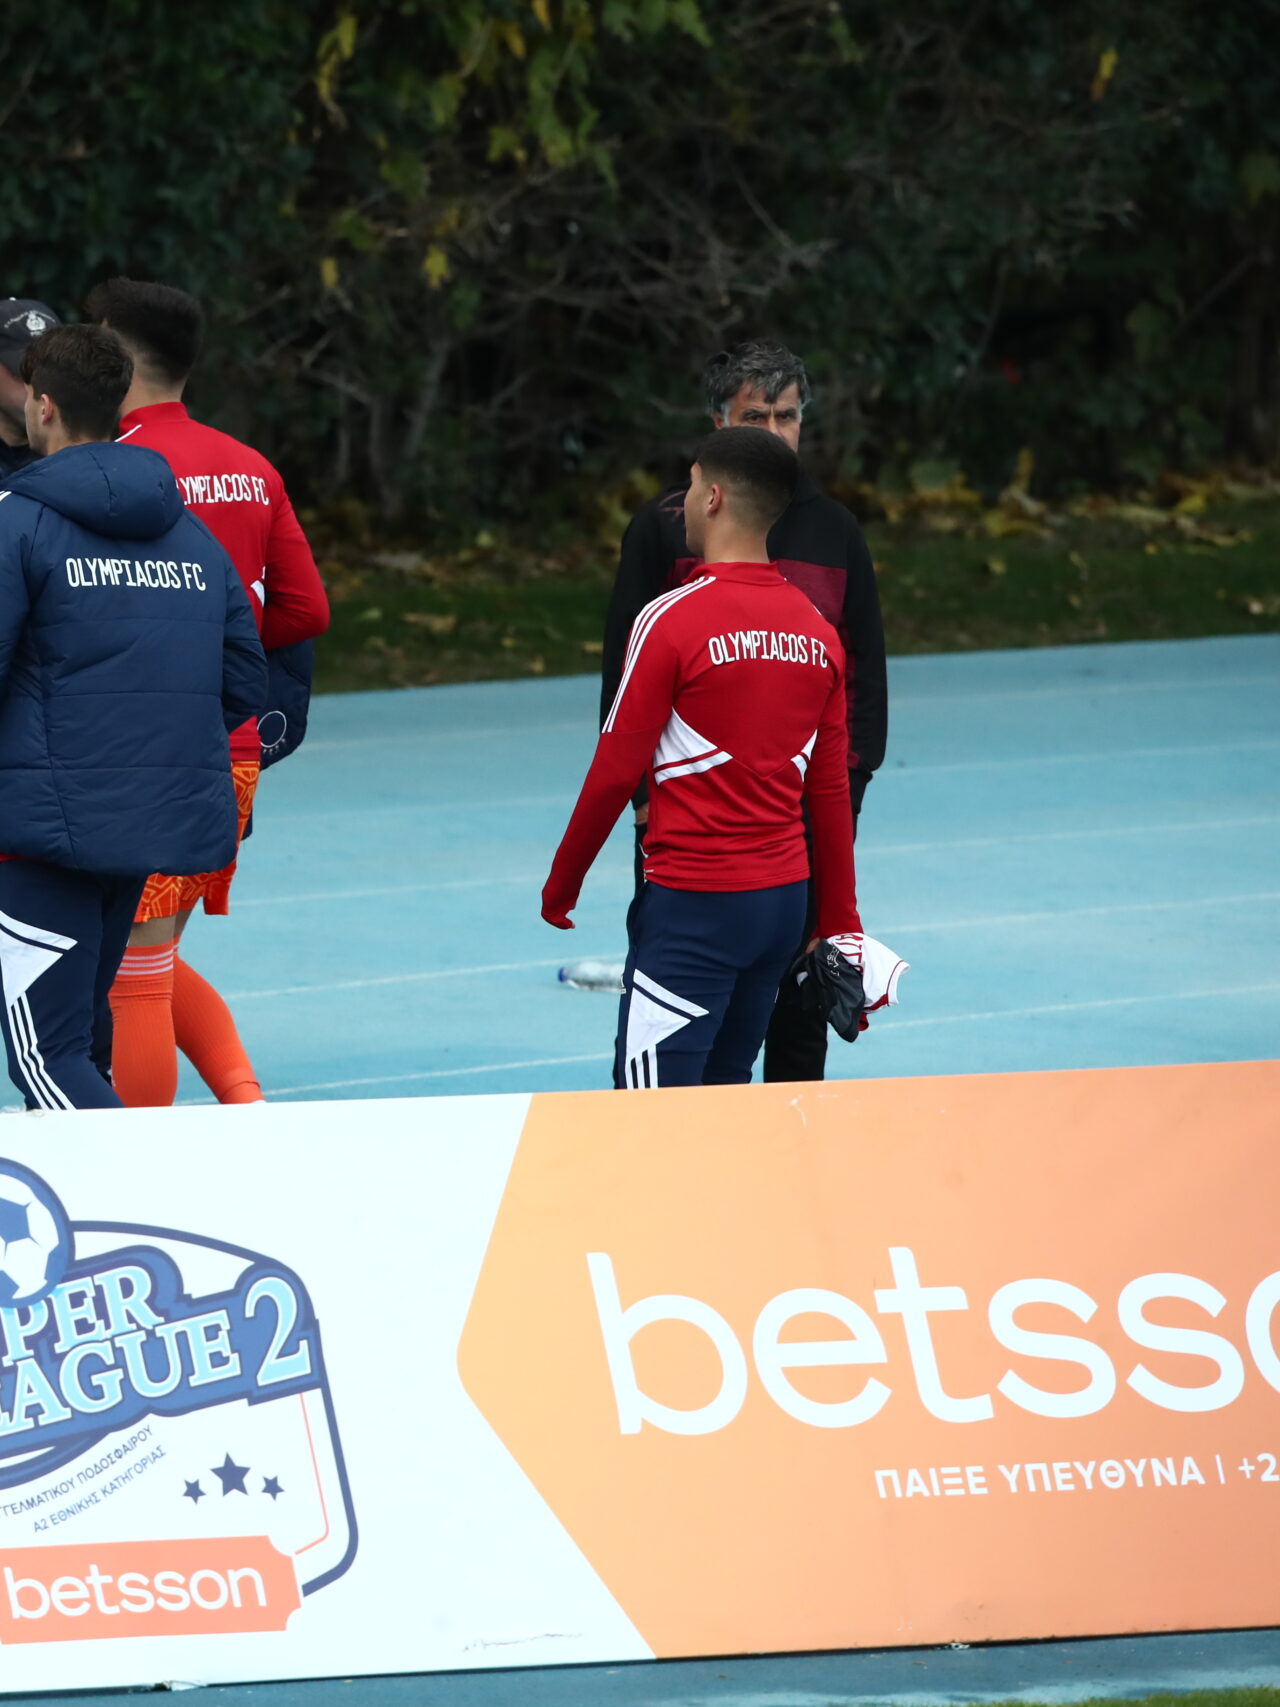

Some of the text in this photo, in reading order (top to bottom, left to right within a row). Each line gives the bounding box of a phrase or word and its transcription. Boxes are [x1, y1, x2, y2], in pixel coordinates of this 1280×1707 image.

[176, 474, 269, 506] YMPIACOS FC
[66, 557, 207, 592] OLYMPIACOS FC
[708, 630, 828, 669] OLYMPIACOS FC
[245, 1276, 312, 1388] 2
[586, 1246, 1280, 1436] betss
[76, 1424, 153, 1485] ΠΟΔΟΣΦΑΙΡΟΥ
[874, 1466, 989, 1499] ΠΑΙΞΕ
[997, 1455, 1207, 1494] ΥΠΕΥΘΥΝΑ
[51, 1492, 102, 1526] ΕΘΝΙΚΗΣ
[101, 1444, 167, 1497] ΚΑΤΗΓΟΡΙΑΣ
[3, 1564, 267, 1620] betsson
